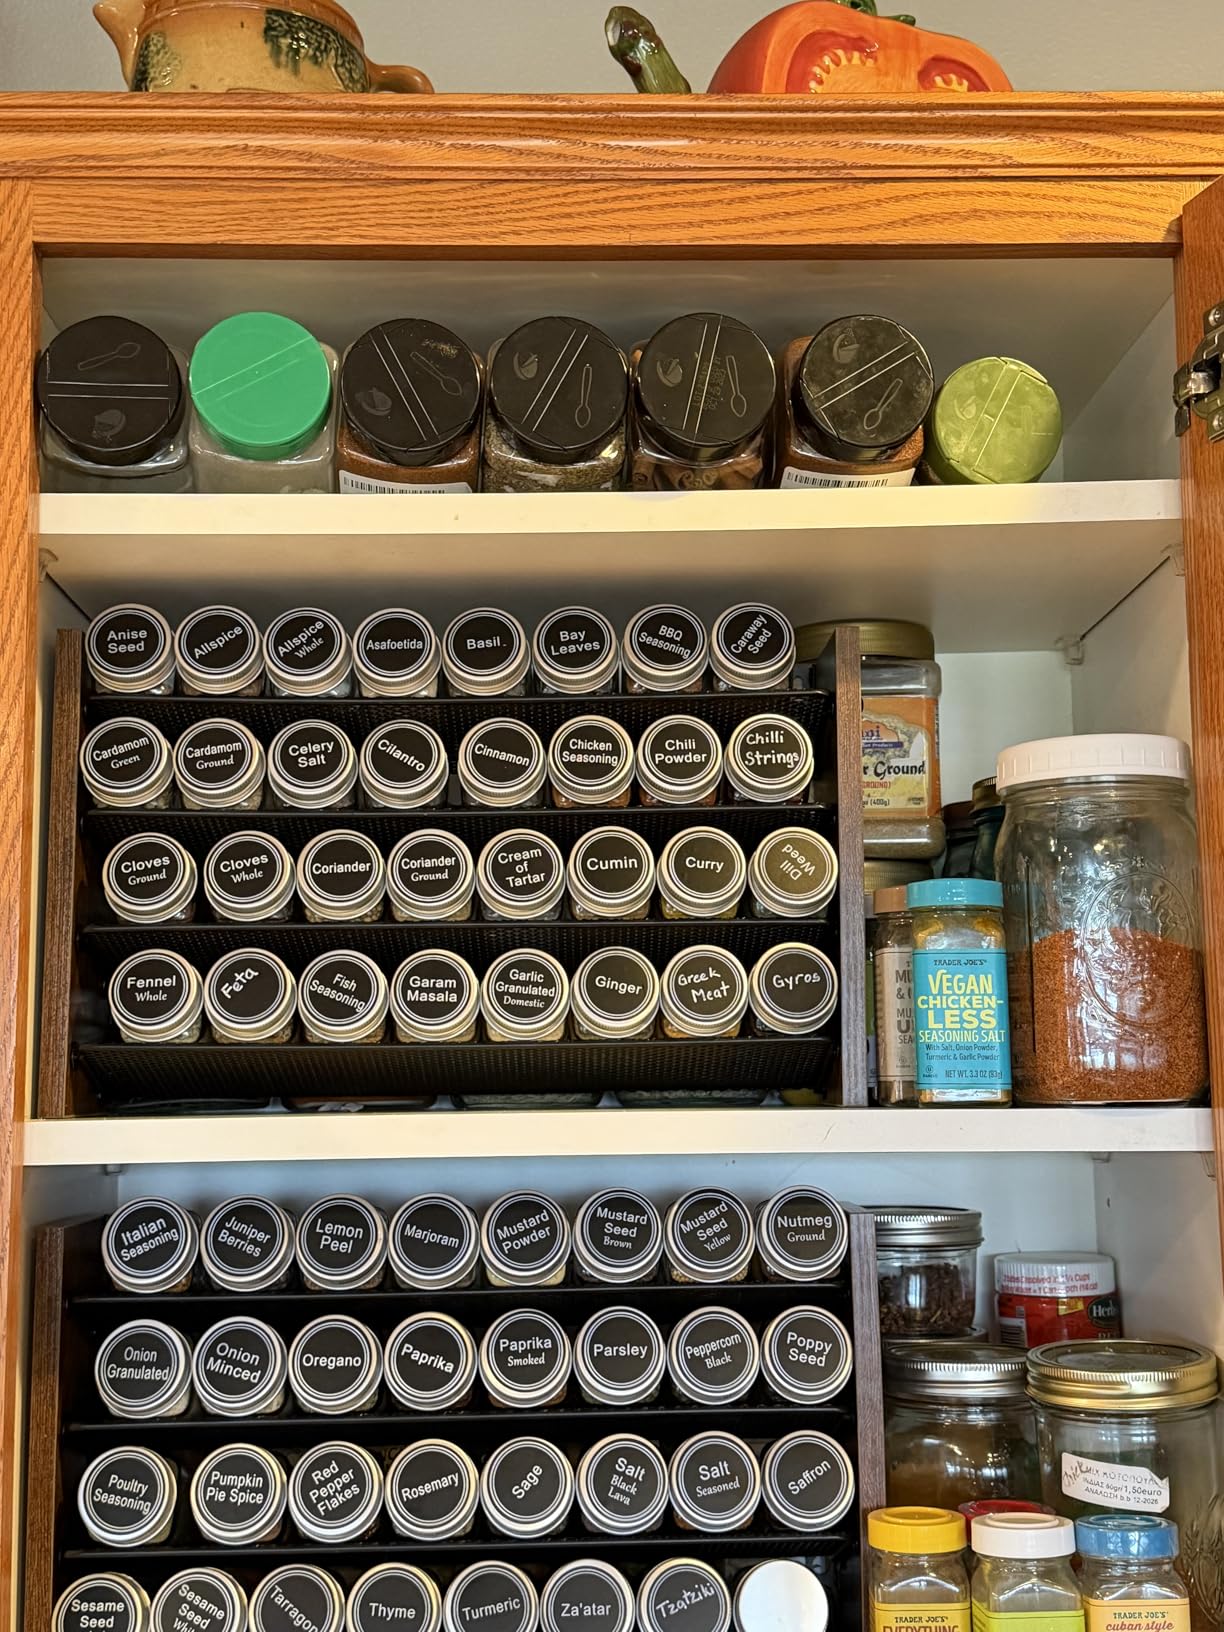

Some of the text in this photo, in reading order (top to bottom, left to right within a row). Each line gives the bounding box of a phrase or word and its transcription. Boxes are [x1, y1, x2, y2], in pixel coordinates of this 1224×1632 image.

[107, 628, 148, 641] Anise
[193, 625, 243, 659] Allspice
[276, 619, 325, 657] Allspice
[559, 629, 586, 643] Bay
[658, 624, 683, 642] BBQ
[730, 613, 768, 655] Caraway
[747, 629, 772, 655] Seed
[107, 641, 145, 654] Seed
[294, 635, 325, 659] Whole
[366, 638, 424, 651] Asafoetida
[550, 640, 601, 657] Leaves
[638, 632, 691, 659] Seasoning
[288, 740, 335, 756] Celery
[569, 738, 613, 752] Chicken
[664, 738, 696, 751] Chili
[746, 731, 784, 746] Chilli
[92, 735, 150, 762] Cardamom
[185, 740, 243, 759] Cardamom
[377, 738, 426, 772] Cilantro
[474, 743, 530, 767] Cinnamon
[655, 751, 708, 764] Powder
[110, 753, 141, 770] Green
[195, 755, 235, 771] Ground
[298, 754, 326, 769] Salt
[562, 751, 619, 767] Seasoning
[744, 750, 800, 768] Strings
[874, 761, 926, 780] Ground
[120, 855, 170, 874] Cloves
[219, 853, 269, 873] Cloves
[401, 855, 456, 870] Coriander
[497, 848, 542, 864] Cream
[586, 856, 638, 871] Cumin
[685, 856, 725, 874] Curry
[781, 843, 816, 876] Weed
[230, 868, 264, 884] Whole
[312, 861, 371, 875] Coriander
[410, 868, 449, 883] Ground
[515, 860, 528, 874] of
[780, 860, 801, 880] Dill
[128, 870, 167, 886] Ground
[505, 871, 546, 889] Tartar
[127, 975, 176, 989] Fennel
[220, 967, 259, 999] Feta
[332, 973, 358, 992] Fish
[409, 975, 457, 989] Garam
[509, 968, 545, 983] Garlic
[594, 975, 643, 995] Ginger
[678, 967, 721, 986] Greek
[772, 972, 821, 990] Gyros
[928, 969, 993, 995] VEGAN
[135, 990, 168, 1002] Whole
[309, 979, 366, 1012] Seasoning
[406, 989, 458, 1003] Masala
[495, 981, 555, 998] Granulated
[690, 983, 730, 1003] Meat
[896, 987, 904, 999] &
[503, 995, 545, 1009] Domestic
[917, 996, 1004, 1009] CHICKEN-
[927, 1010, 997, 1029] LESS
[919, 1030, 979, 1043] SEASONING
[981, 1030, 1006, 1043] SALT
[926, 1053, 952, 1061] Turmeric
[959, 1053, 976, 1061] Garlic
[977, 1053, 1000, 1061] Powder
[945, 1070, 957, 1078] NET
[969, 1070, 979, 1078] 3.3
[979, 1070, 987, 1078] OZ
[496, 1210, 550, 1241] Mustard
[596, 1207, 648, 1225] Mustard
[680, 1201, 729, 1234] Mustard
[777, 1214, 832, 1230] Nutmeg
[120, 1218, 167, 1246] Italian
[225, 1216, 271, 1245] Juniper
[315, 1218, 364, 1239] Lemon
[404, 1223, 460, 1249] Marjoram
[604, 1222, 637, 1238] Seed
[696, 1218, 729, 1242] Seed
[787, 1230, 826, 1243] Ground
[121, 1228, 179, 1262] Seasoning
[217, 1230, 262, 1257] Berries
[319, 1235, 353, 1254] Peel
[501, 1226, 551, 1254] Powder
[603, 1235, 632, 1250] Brown
[704, 1233, 732, 1252] Yellow
[499, 1336, 553, 1353] Paprika
[593, 1343, 648, 1359] Parsley
[685, 1332, 742, 1360] Peppercorn
[786, 1332, 833, 1355] Poppy
[124, 1346, 157, 1362] Onion
[216, 1342, 260, 1366] Onion
[302, 1354, 362, 1370] Oregano
[401, 1344, 455, 1373] Paprika
[507, 1353, 546, 1368] Smoked
[704, 1352, 733, 1370] Black
[788, 1347, 826, 1367] Seed
[107, 1364, 170, 1381] Granulated
[206, 1356, 261, 1383] Minced
[311, 1460, 339, 1485] Red
[614, 1457, 646, 1481] Salt
[698, 1460, 731, 1482] Salt
[788, 1459, 831, 1496] Saffron
[108, 1474, 149, 1497] Poultry
[210, 1471, 264, 1489] Pumpkin
[308, 1468, 356, 1503] Pepper
[401, 1472, 460, 1502] Rosemary
[511, 1464, 544, 1499] Sage
[610, 1474, 638, 1495] Black
[695, 1477, 741, 1497] Seasoned
[93, 1488, 152, 1515] Seasoning
[205, 1486, 264, 1505] Pie Spice
[317, 1484, 361, 1516] Flakes
[608, 1486, 631, 1505] Lava
[71, 1599, 125, 1613] Sesame
[177, 1584, 225, 1620] Sesame
[462, 1596, 521, 1621] Turmeric
[560, 1602, 612, 1617] Za'atar
[655, 1583, 715, 1619] Tzatziki
[178, 1603, 211, 1630] Seed
[369, 1602, 416, 1620] Thyme
[79, 1615, 115, 1629] Seed
[1105, 1620, 1175, 1632] cuban style
